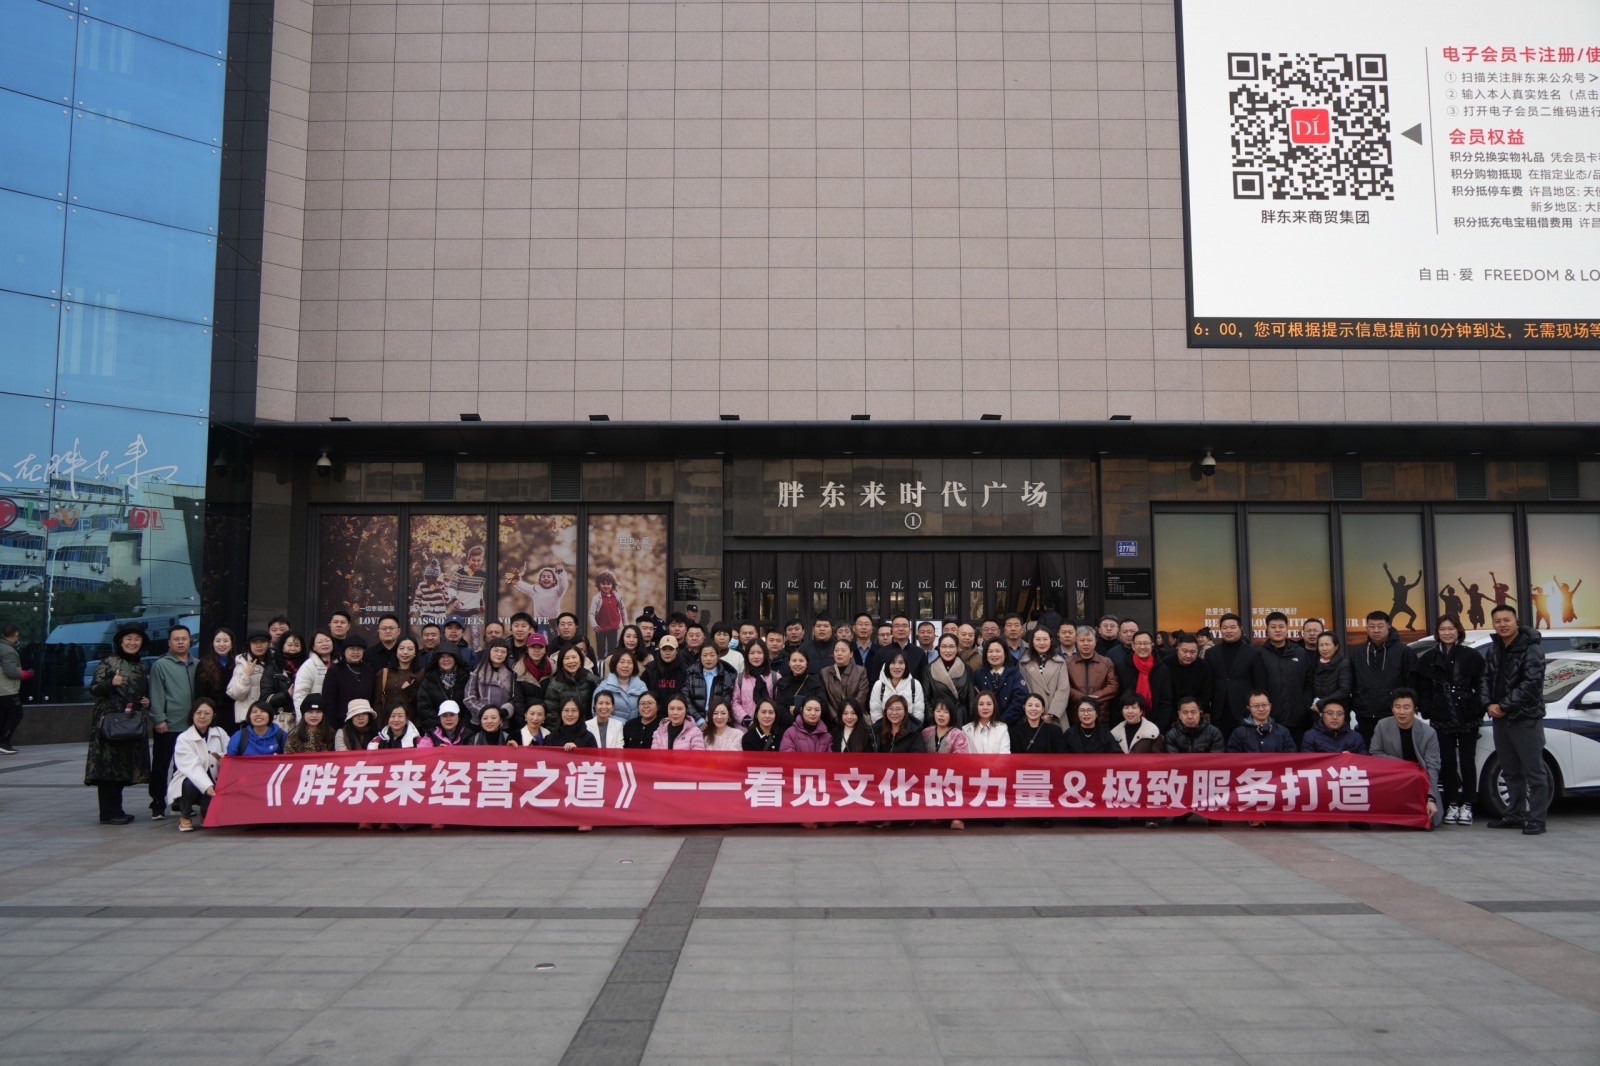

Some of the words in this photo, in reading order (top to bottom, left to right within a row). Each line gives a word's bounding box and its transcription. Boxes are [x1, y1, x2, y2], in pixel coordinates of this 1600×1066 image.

[1442, 45, 1600, 63] 电子会员卡注册/使
[1463, 105, 1600, 117] 打开电子会员二维码进行
[1449, 128, 1525, 146] 会员权益
[1449, 151, 1545, 163] 积分兑换实物礼品
[1550, 152, 1600, 163] 凭会员卡
[1451, 168, 1523, 180] 积分购物抵现
[1452, 185, 1523, 197] 积分抵停车费
[1531, 202, 1600, 213] 新乡地区：大
[1261, 209, 1370, 225] 胖东来商贸集团
[1454, 217, 1573, 229] 积分抵充电宝租借费用
[1484, 268, 1560, 281] FREEDOM
[1564, 269, 1576, 281] &
[777, 480, 1049, 509] 胖东来时代广场
[129, 506, 165, 532] DL
[359, 616, 379, 625] LOV
[410, 616, 447, 625] PASSIO
[1204, 619, 1219, 627] BE
